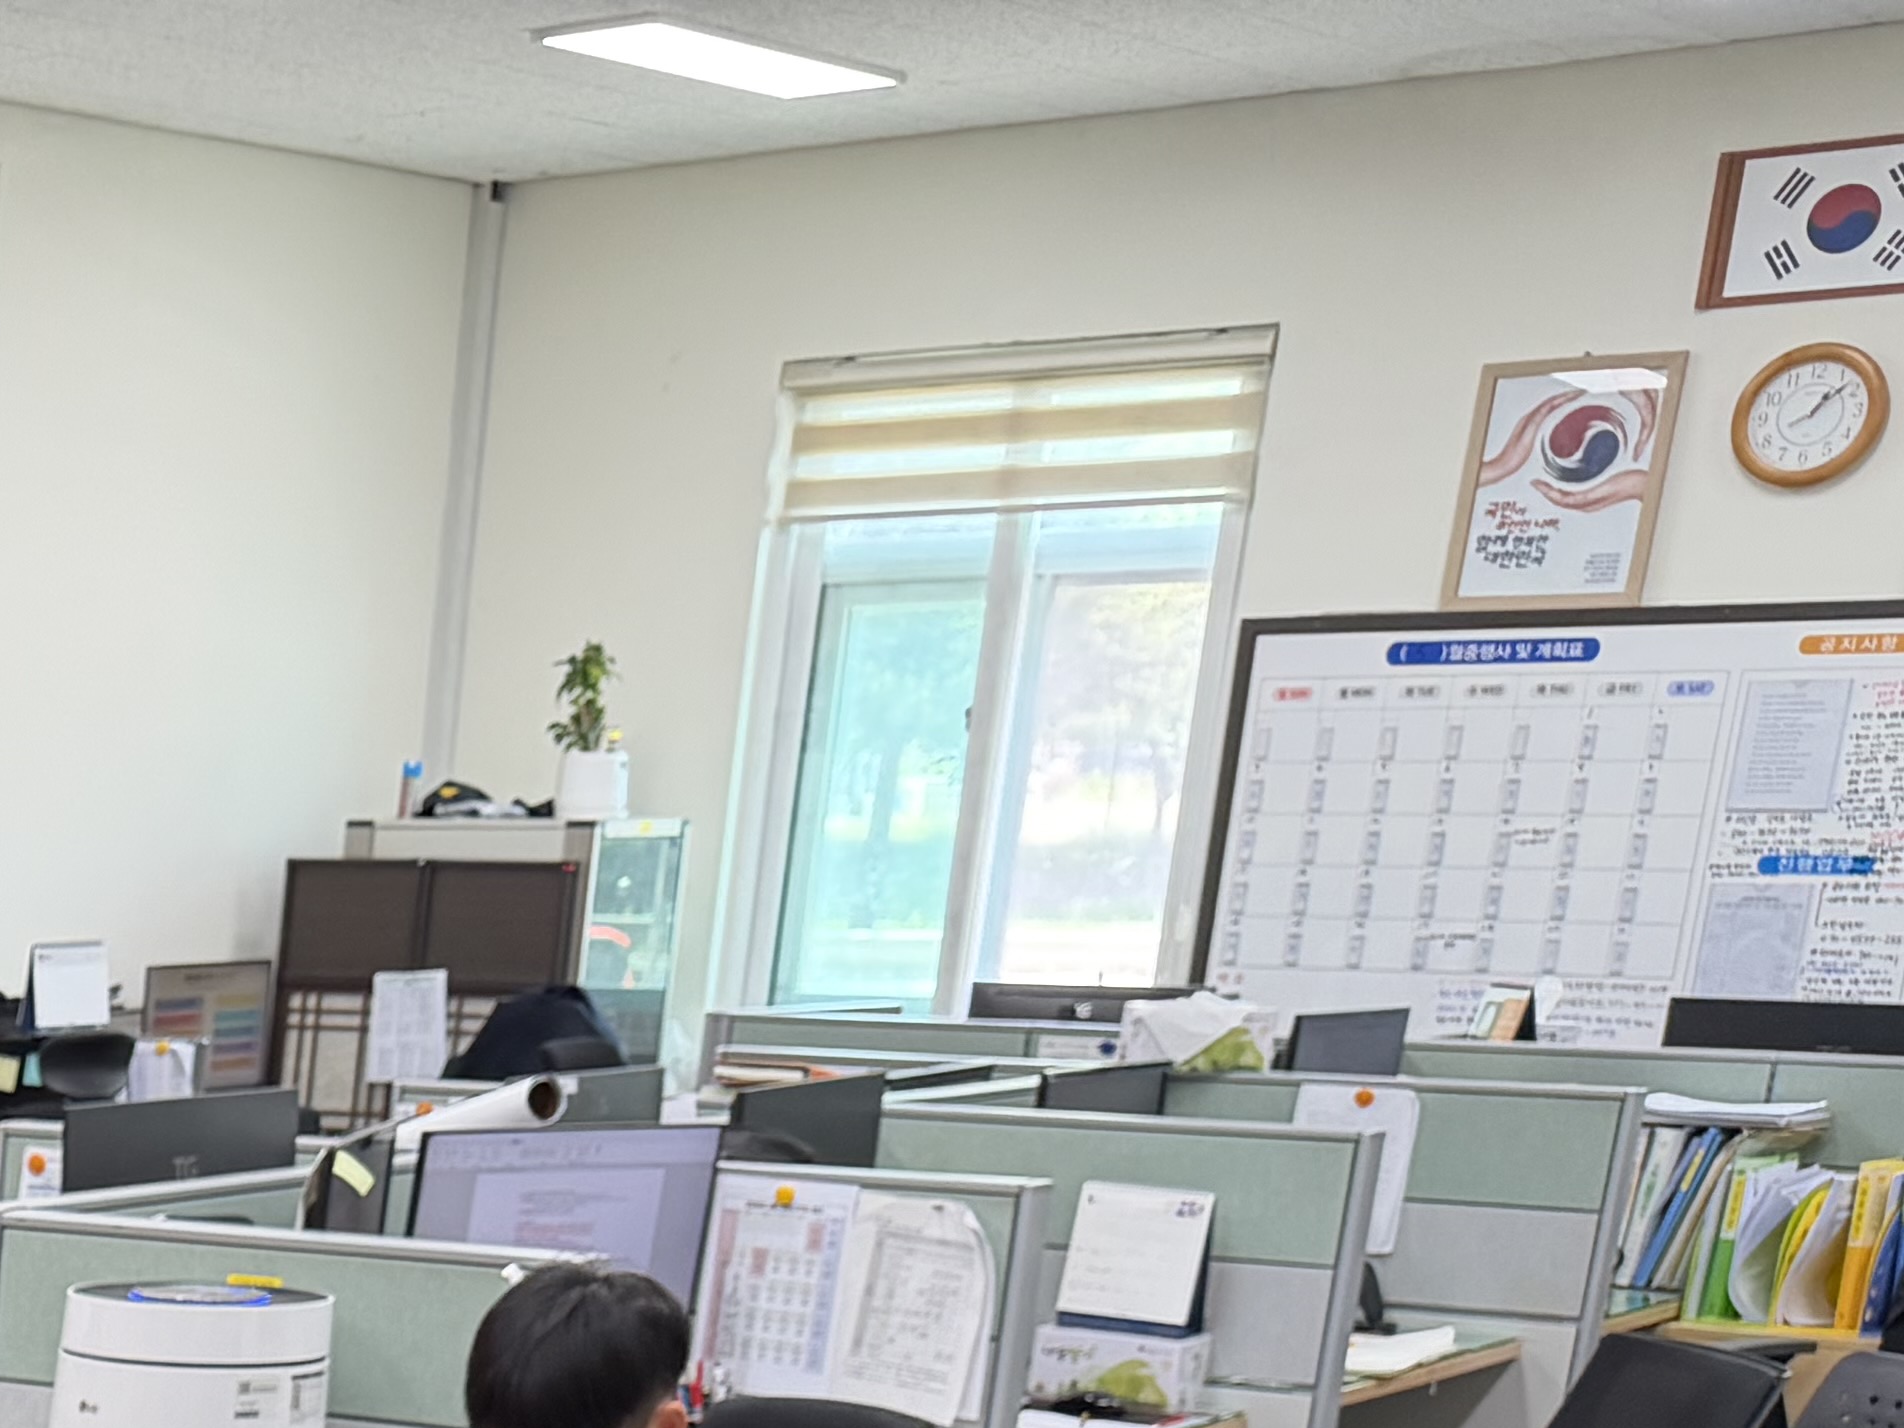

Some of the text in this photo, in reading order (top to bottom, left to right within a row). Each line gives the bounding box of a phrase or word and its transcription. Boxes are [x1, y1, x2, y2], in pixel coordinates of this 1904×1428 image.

[1811, 364, 1827, 379] 12
[1787, 372, 1800, 388] 11
[1848, 382, 1860, 398] 2
[1765, 391, 1782, 407] 10
[1852, 402, 1863, 418] 3
[1758, 411, 1768, 428] 9
[1841, 426, 1851, 439] 4
[1761, 434, 1772, 449] 8
[1822, 441, 1832, 457] 5
[1779, 446, 1788, 461] 7
[1798, 450, 1808, 465] 6
[1820, 634, 1898, 653] 공지사항
